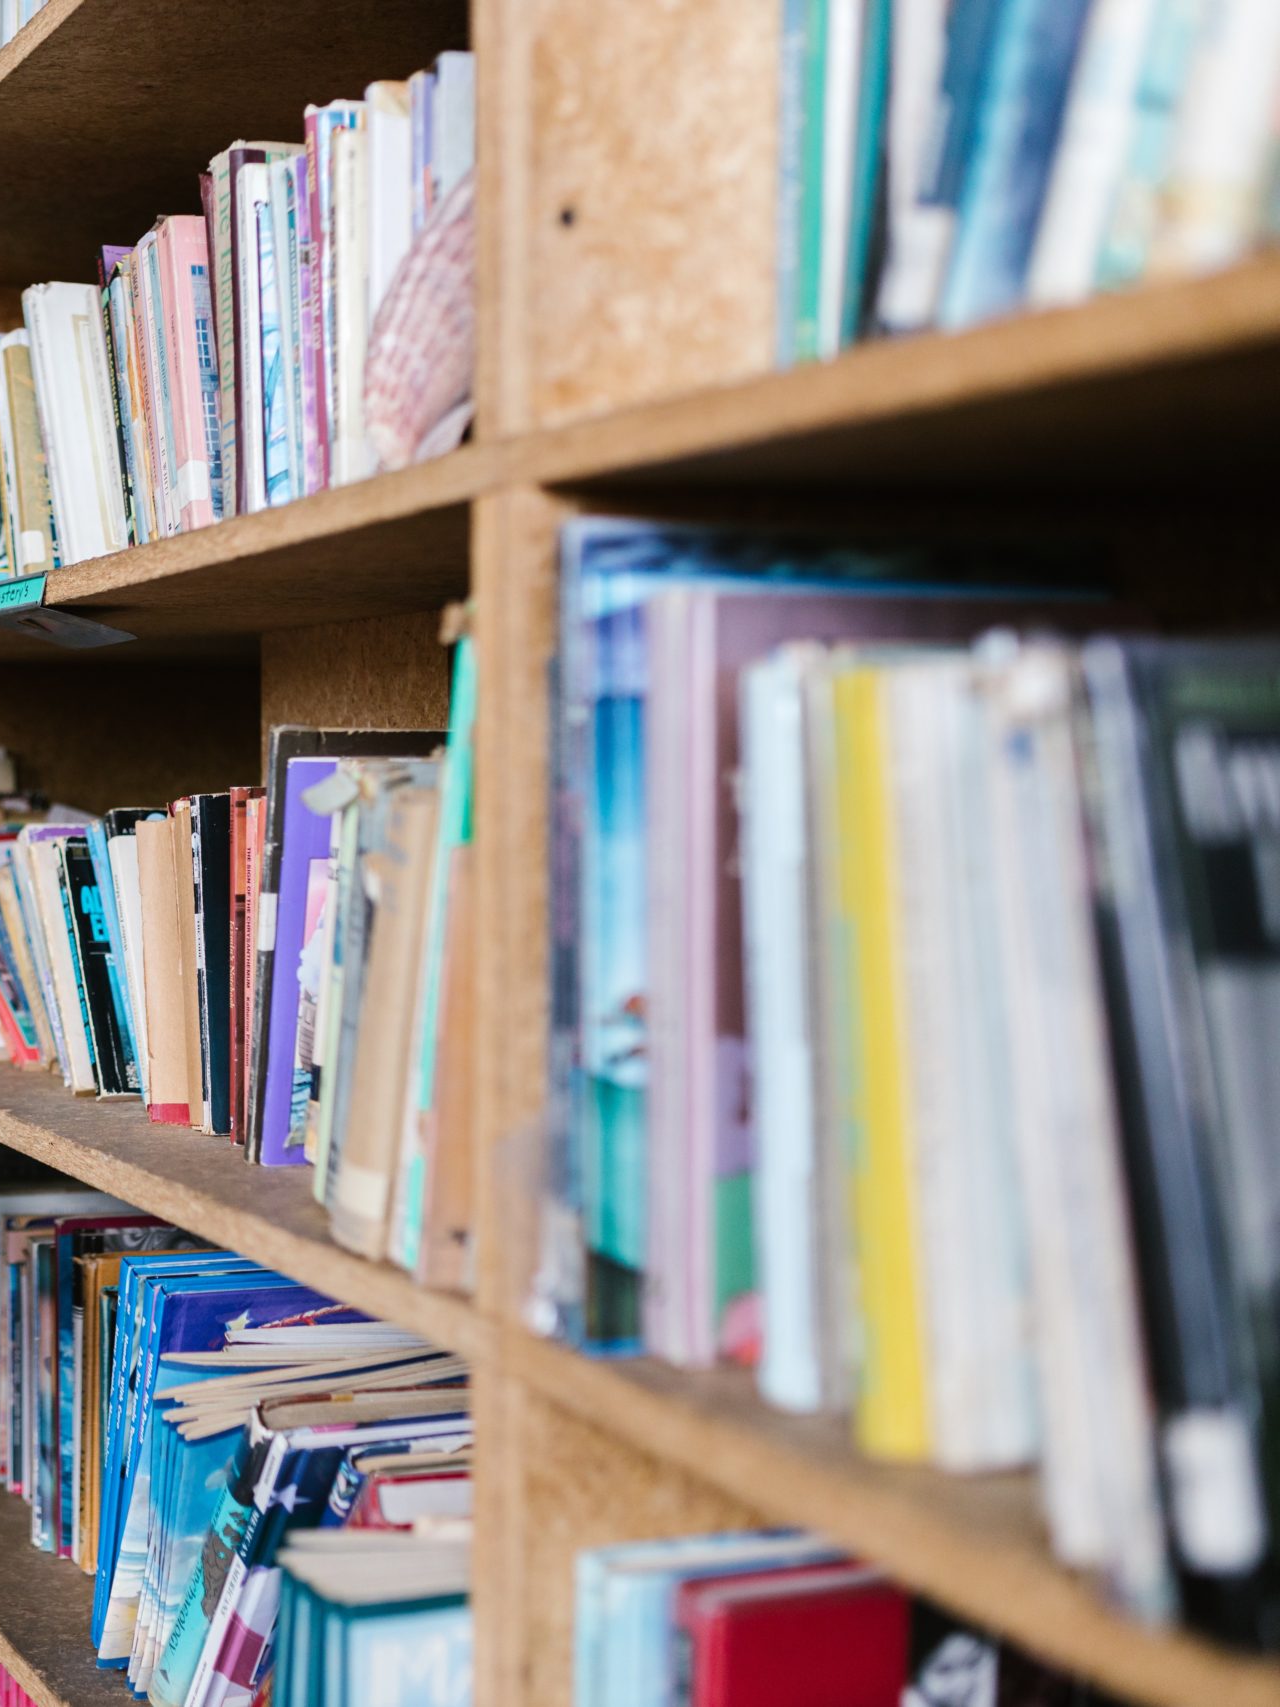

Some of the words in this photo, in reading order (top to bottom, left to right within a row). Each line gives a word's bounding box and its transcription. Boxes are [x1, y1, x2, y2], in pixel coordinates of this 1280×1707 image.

[215, 168, 231, 234] The
[218, 246, 235, 348] Island
[221, 359, 235, 393] of
[239, 1509, 261, 1559] MEXICAN
[220, 1563, 243, 1616] AMERICANS
